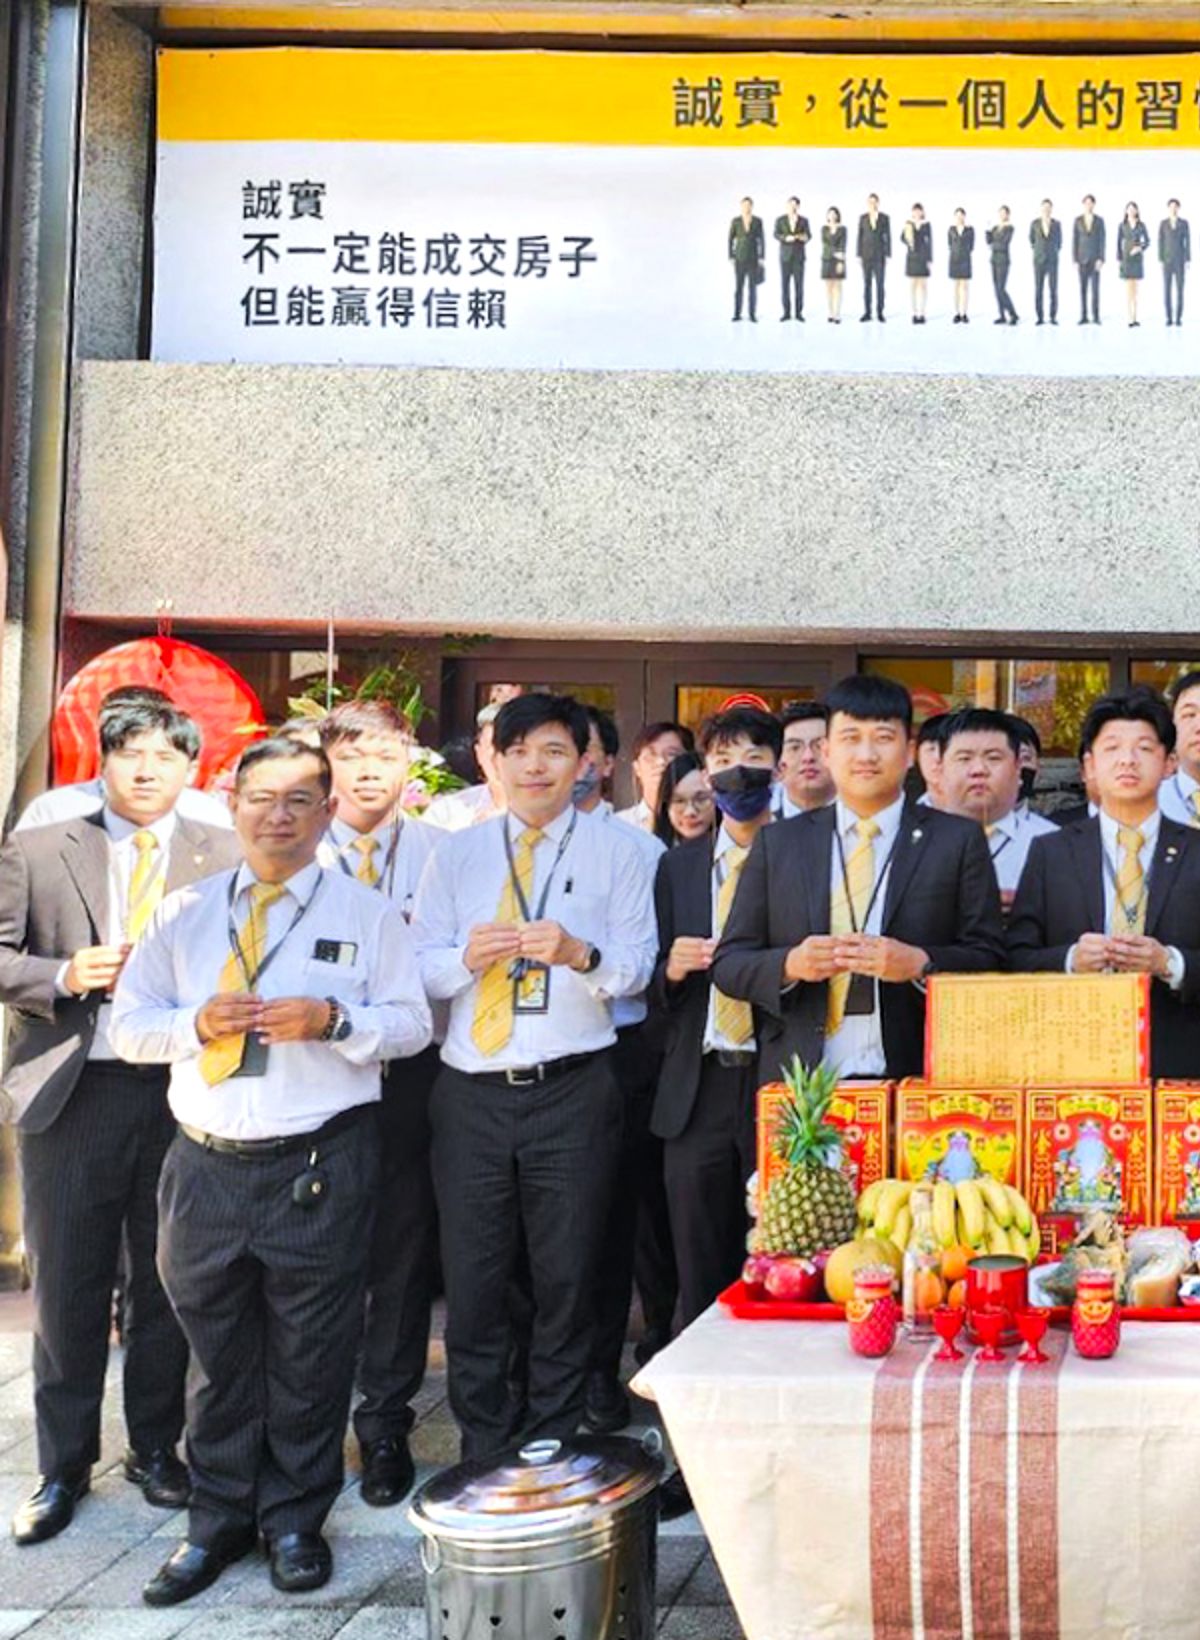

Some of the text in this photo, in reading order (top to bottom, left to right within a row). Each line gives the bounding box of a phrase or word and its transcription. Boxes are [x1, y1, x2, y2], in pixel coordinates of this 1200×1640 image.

[242, 179, 326, 220] 誠實
[242, 231, 597, 278] 不一定能成交房子
[240, 286, 506, 329] 但能贏得信賴
